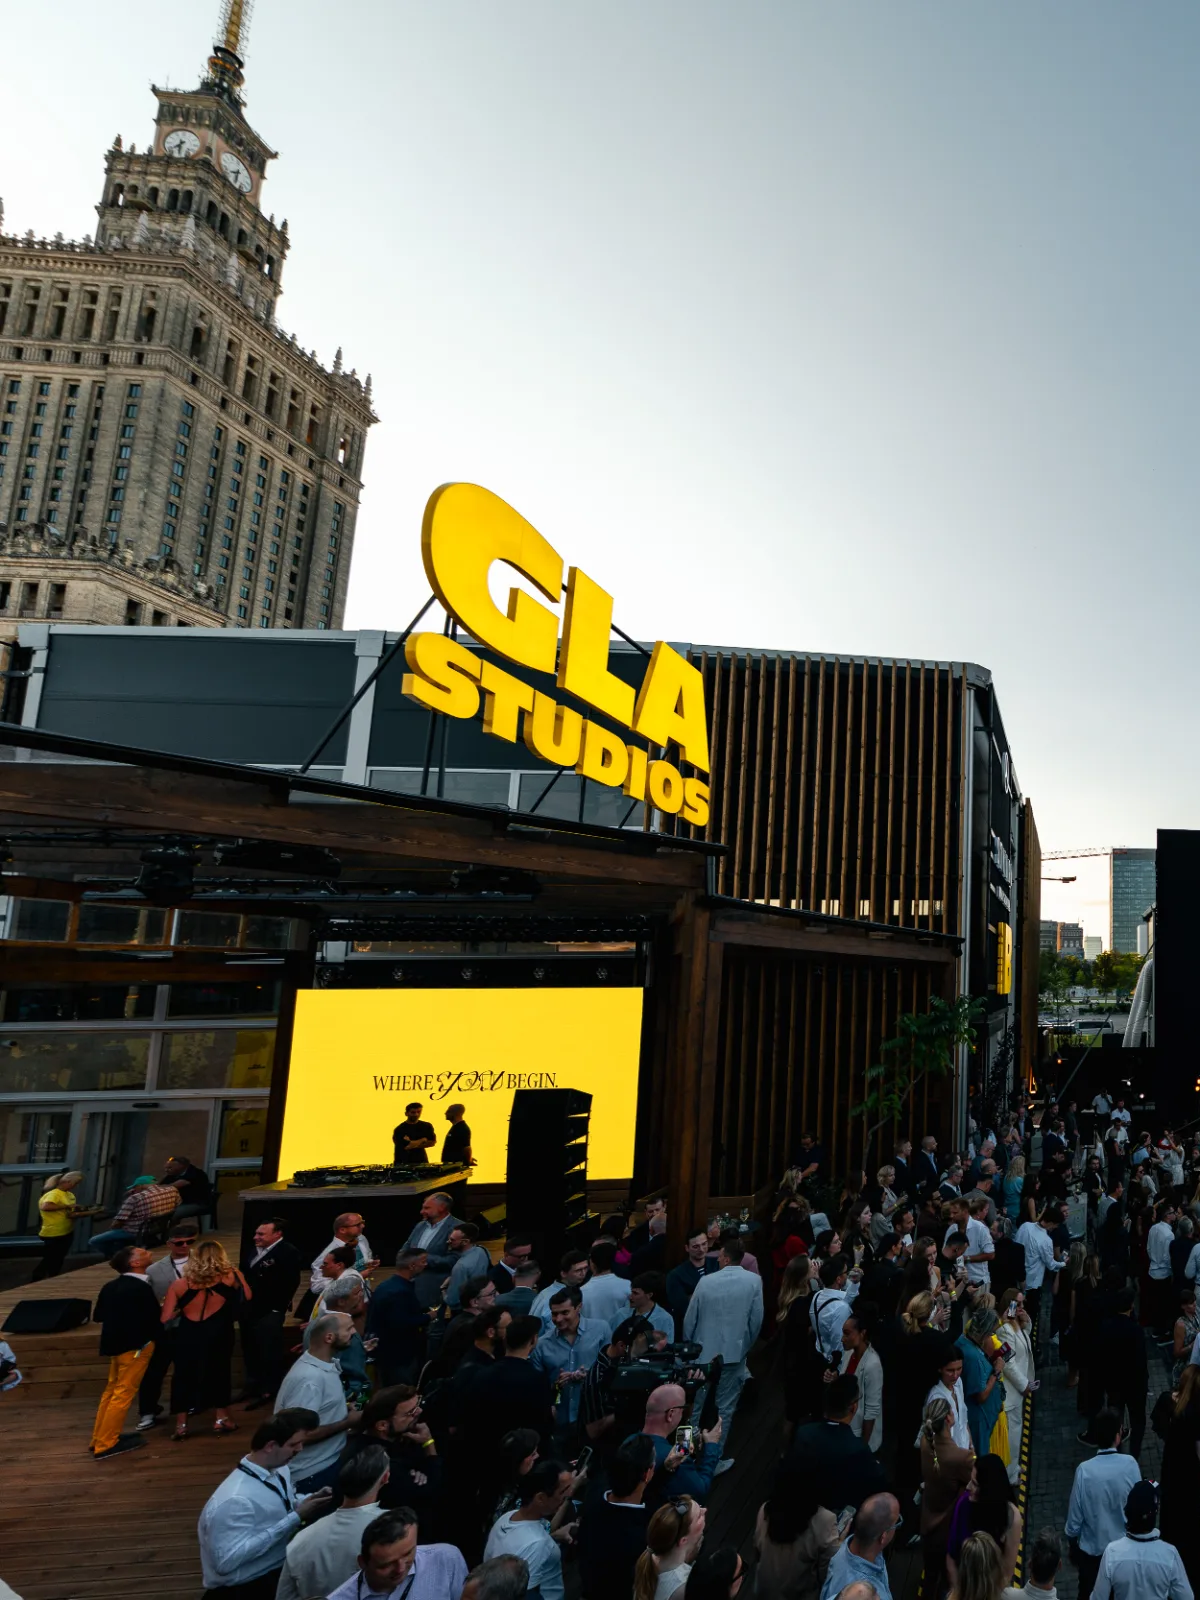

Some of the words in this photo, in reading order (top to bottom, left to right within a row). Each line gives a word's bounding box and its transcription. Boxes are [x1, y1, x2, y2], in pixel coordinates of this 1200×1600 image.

[421, 482, 710, 774] GLA
[402, 632, 710, 826] STUDIOS
[373, 1075, 434, 1091] WHERE
[507, 1072, 559, 1090] BEGIN.
